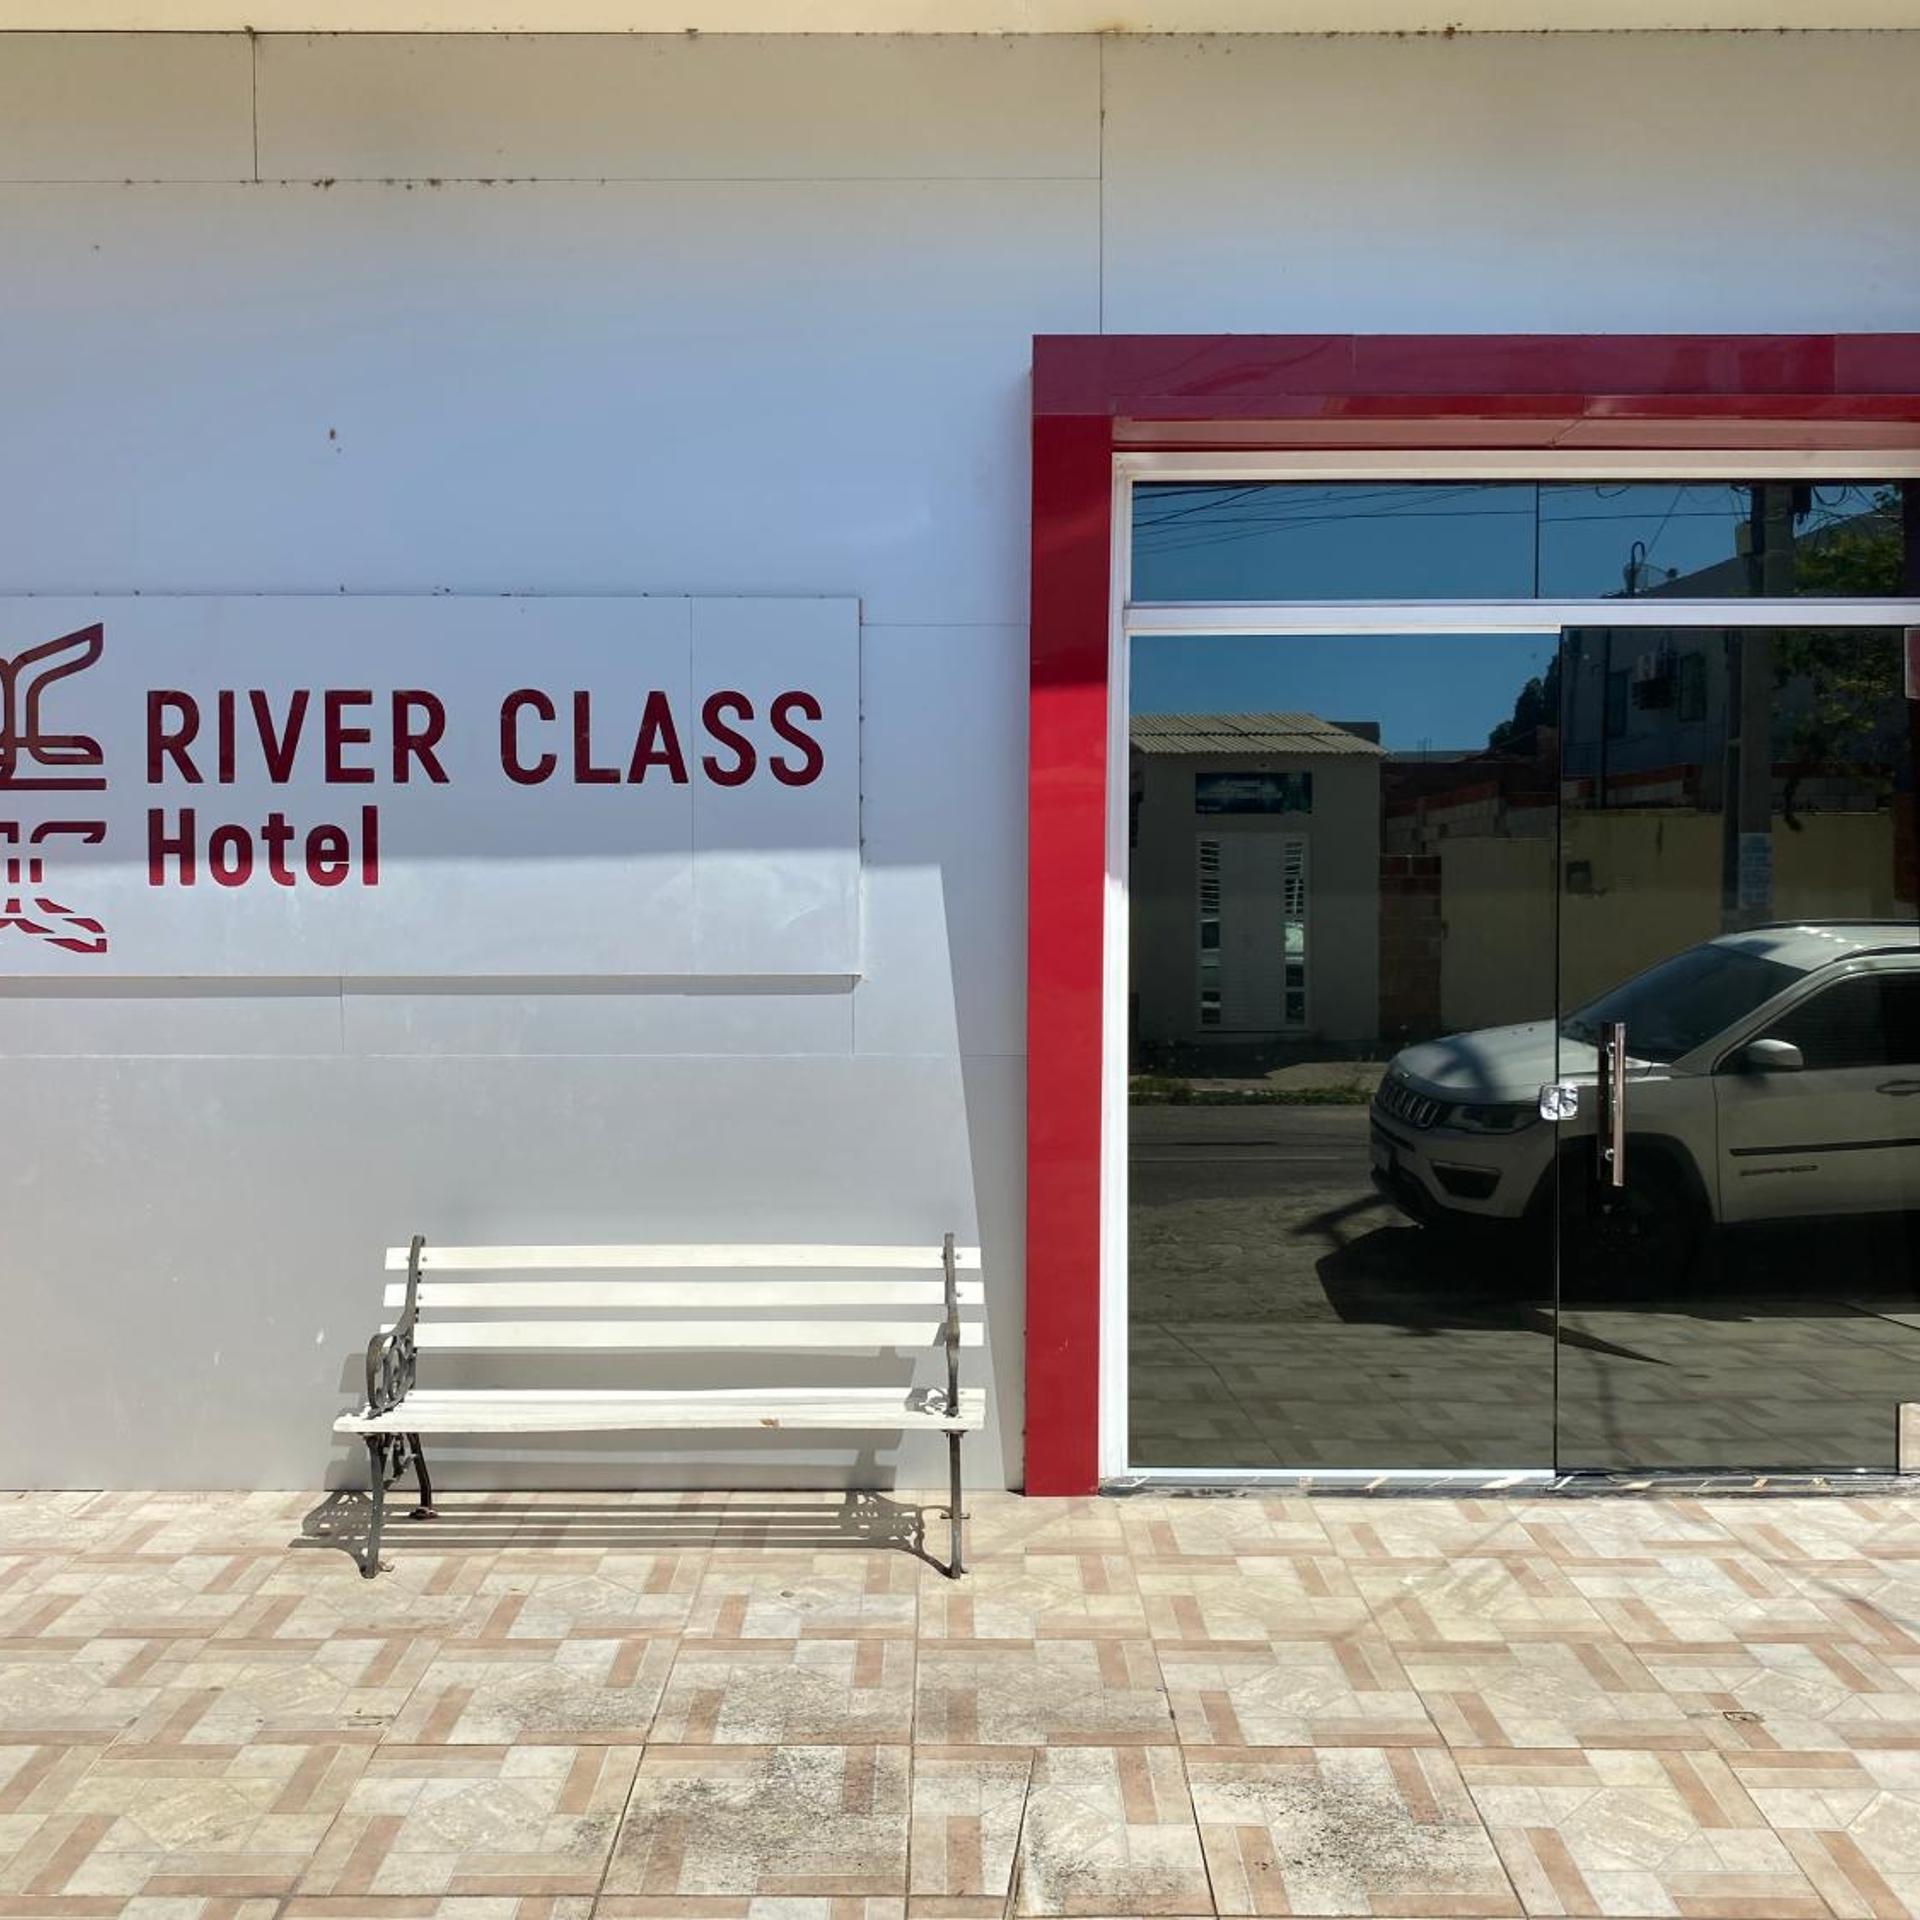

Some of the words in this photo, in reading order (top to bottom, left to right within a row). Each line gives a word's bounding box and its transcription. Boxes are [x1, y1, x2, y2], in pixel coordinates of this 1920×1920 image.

[147, 690, 450, 784] RIVER
[499, 689, 824, 786] CLASS
[147, 805, 380, 887] Hotel
